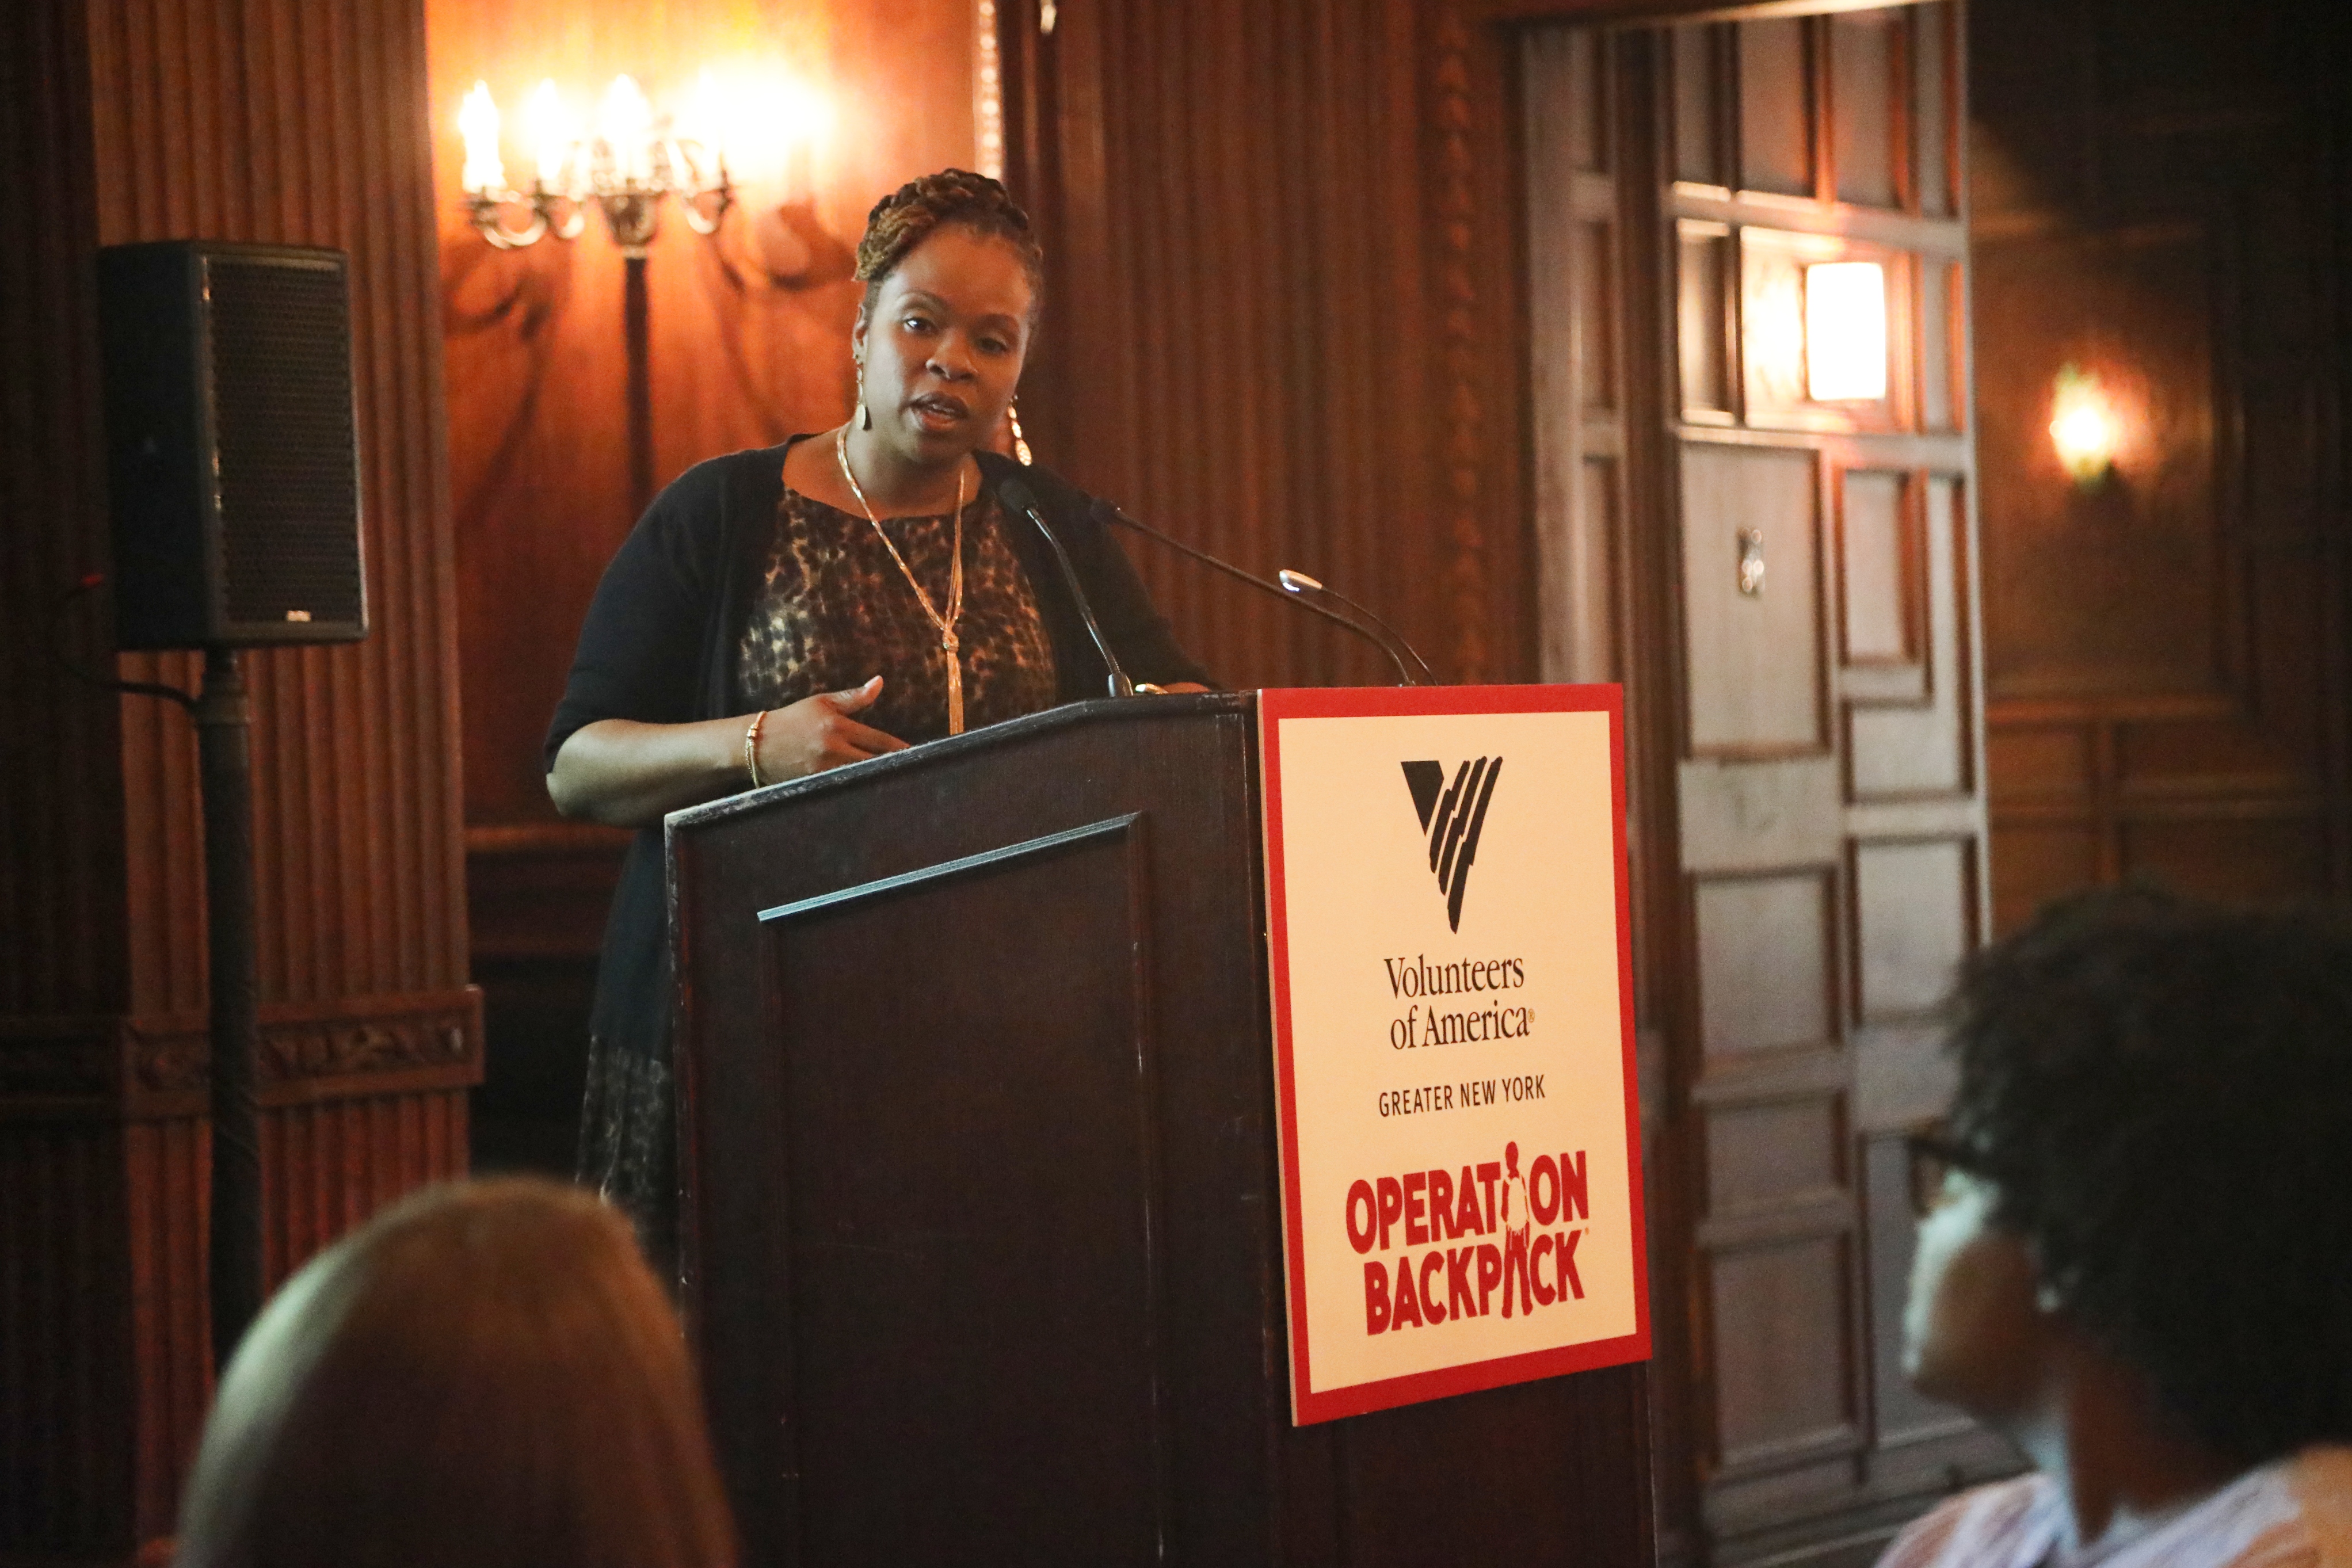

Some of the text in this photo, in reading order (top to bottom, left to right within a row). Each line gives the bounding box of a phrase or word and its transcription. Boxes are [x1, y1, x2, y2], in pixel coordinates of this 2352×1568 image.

[1383, 953, 1524, 999] Volunteers
[1390, 1005, 1418, 1050] of
[1379, 1074, 1546, 1117] GREATER NEW YORK
[1345, 1141, 1589, 1255] OPERATION
[1363, 1229, 1585, 1336] BACKPACK
